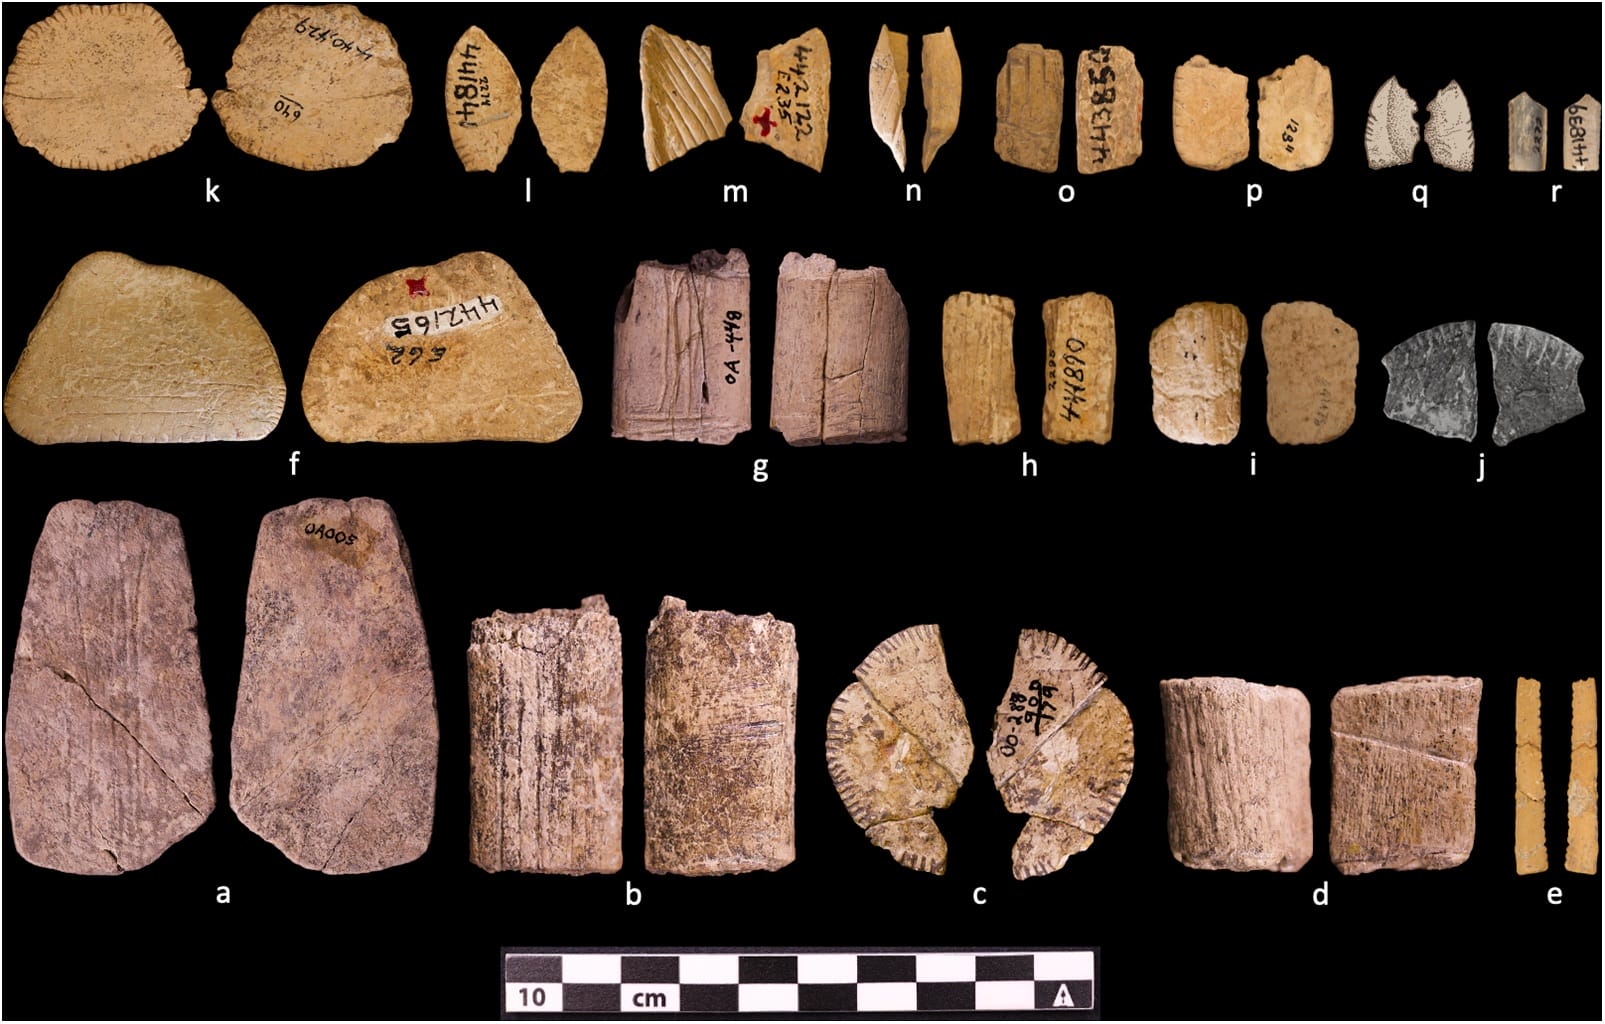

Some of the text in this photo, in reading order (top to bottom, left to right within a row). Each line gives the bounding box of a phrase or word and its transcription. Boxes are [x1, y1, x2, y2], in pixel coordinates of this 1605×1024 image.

[274, 100, 303, 122] 640
[775, 70, 792, 126] E235
[788, 45, 813, 142] 442122
[391, 295, 499, 338] 442165
[520, 988, 666, 1007] 10 cm
